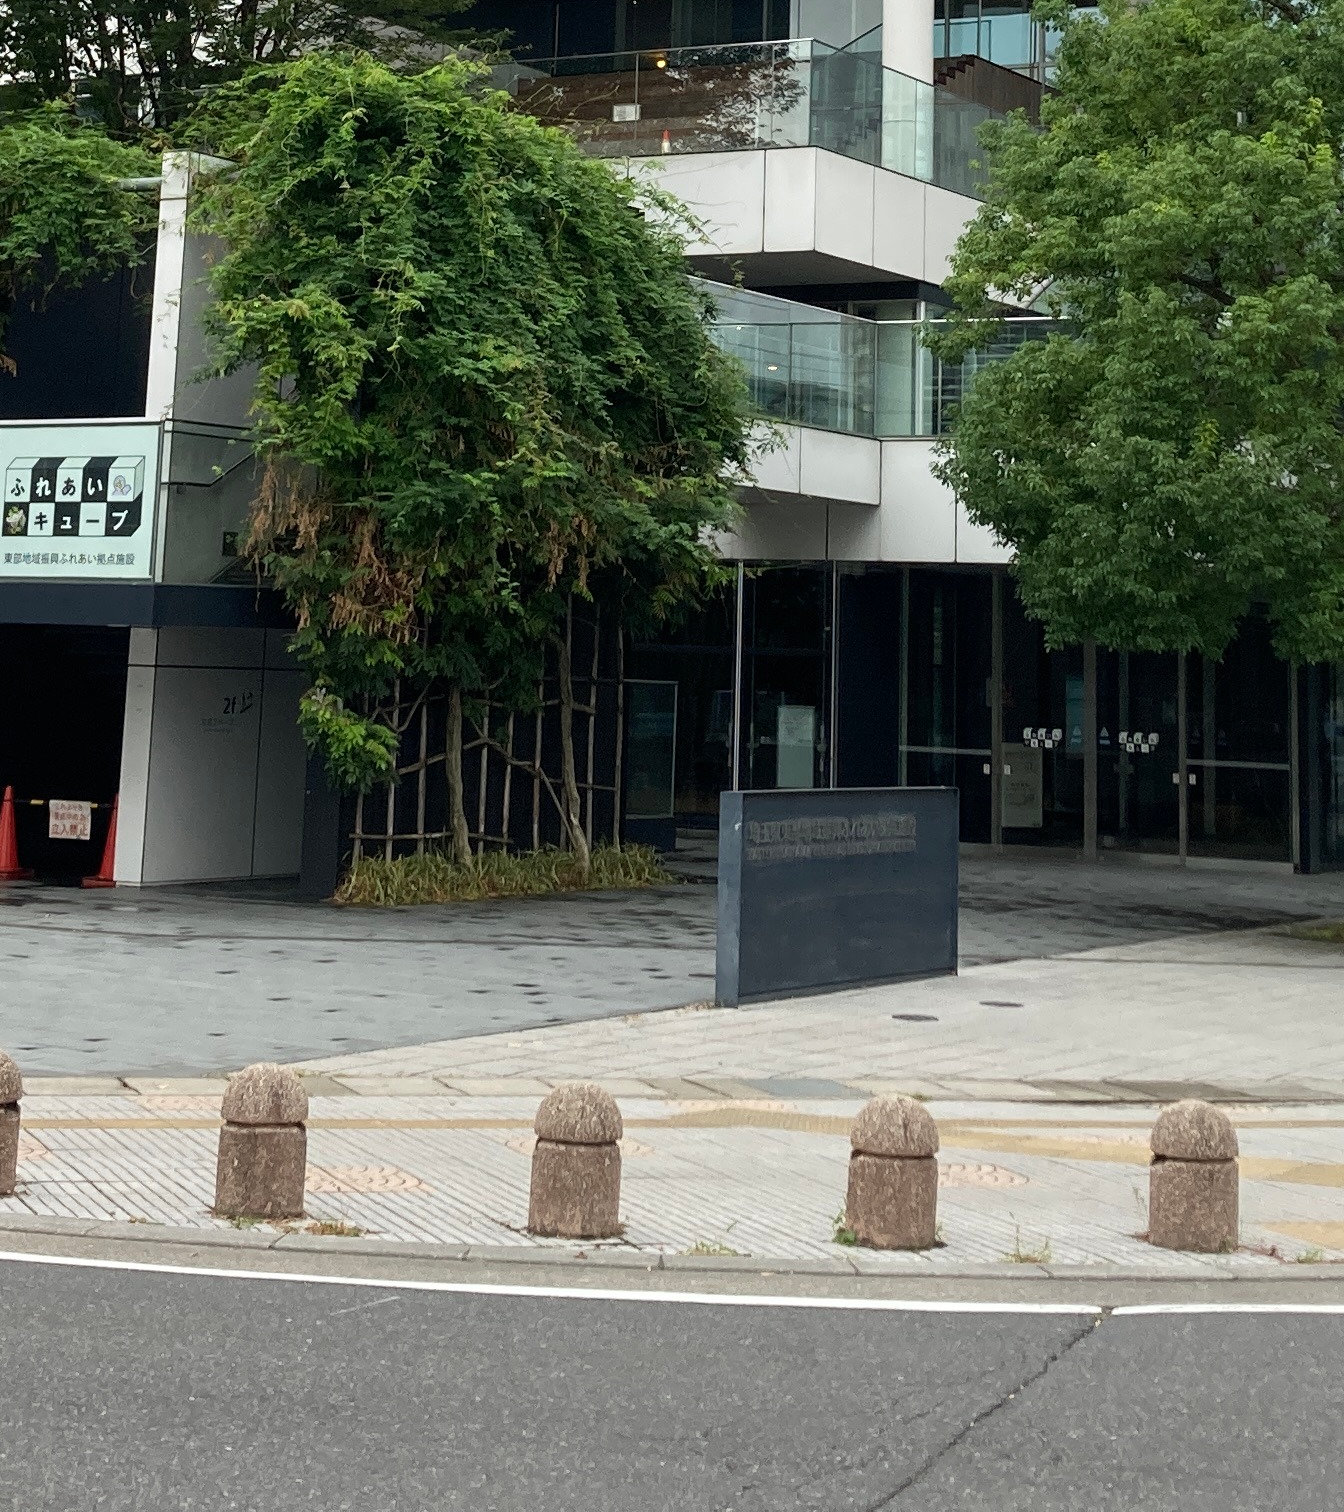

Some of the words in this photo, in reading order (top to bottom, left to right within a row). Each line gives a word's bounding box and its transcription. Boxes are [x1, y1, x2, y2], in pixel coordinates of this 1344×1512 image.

[10, 477, 104, 498] ふれあい
[33, 509, 129, 532] キューブ
